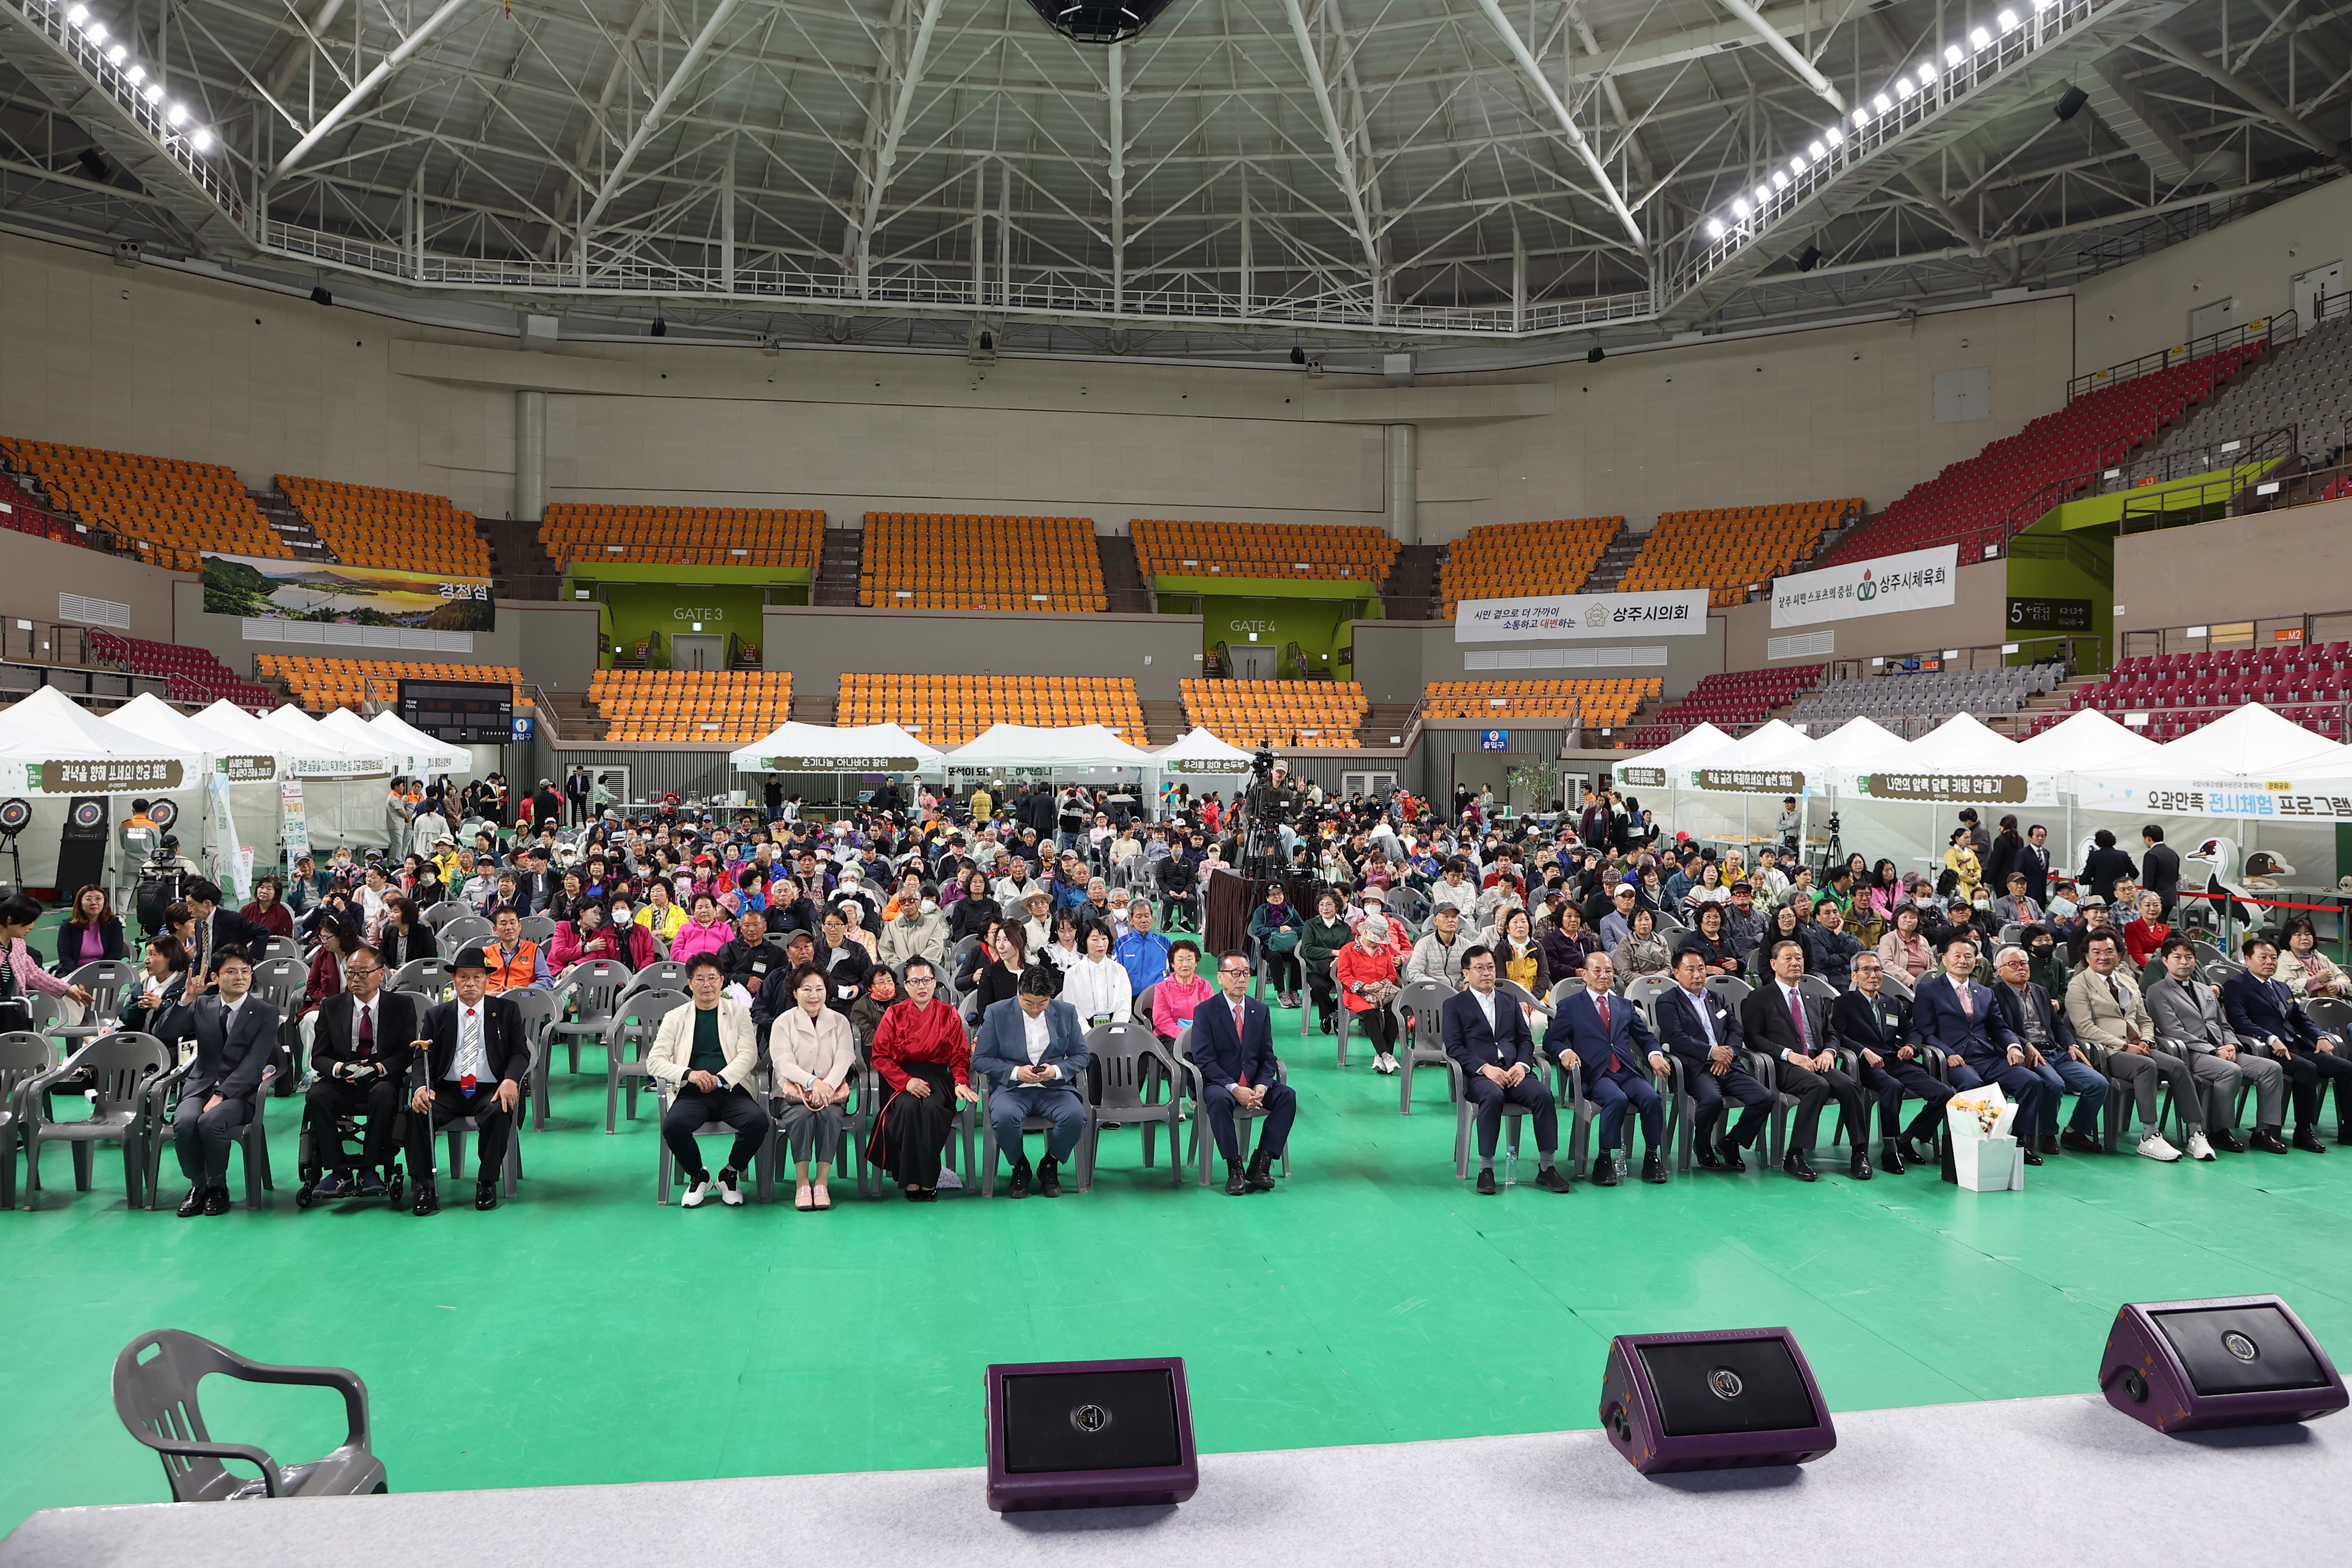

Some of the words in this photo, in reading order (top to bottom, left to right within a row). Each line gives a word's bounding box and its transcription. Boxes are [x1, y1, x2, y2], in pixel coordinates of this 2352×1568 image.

[2147, 477, 2153, 485] L3
[1880, 567, 1945, 593] 상주시체육회
[438, 582, 488, 601] 경천섬
[1793, 592, 1806, 605] 시민
[1807, 587, 1835, 602] 스포츠의
[673, 607, 712, 620] GATE
[714, 608, 723, 620] 3
[1474, 610, 1491, 620] 시민
[1493, 609, 1519, 619] 곁으로
[1522, 608, 1530, 617] 더
[1532, 606, 1559, 617] 가까이
[1613, 605, 1689, 622] 상주시의회
[2011, 603, 2022, 622] 5
[1230, 620, 1265, 631] GATE
[1268, 621, 1276, 632] 4
[1503, 620, 1537, 630] 소통하고
[1540, 618, 1576, 629] 대변하는
[2288, 630, 2300, 640] M2
[520, 721, 524, 730] 1
[308, 760, 320, 772] 심장을
[322, 761, 330, 771] 다시
[339, 761, 347, 771] 하는
[353, 760, 361, 771] 지금
[802, 758, 834, 767] 온기나눔
[836, 758, 870, 767] 아나바다
[872, 758, 888, 767] 장터
[1207, 761, 1221, 769] 엄마
[1223, 761, 1244, 769] 손두부
[61, 765, 88, 781] 과녁을
[90, 765, 107, 781] 향해
[108, 765, 134, 781] 쏘세요!
[136, 765, 150, 780] 한궁
[152, 764, 167, 779] 체험
[1733, 773, 1764, 785] 득점하세요!
[1765, 775, 1778, 786] 슐런
[1779, 774, 1792, 787] 체험
[1886, 777, 1911, 790] 나만의
[1913, 778, 1929, 792] 알록
[1932, 778, 1949, 793] 달록
[1952, 779, 1970, 793] 키링
[1973, 779, 2002, 793] 만들기
[2147, 791, 2204, 812] 오감만족
[2209, 793, 2273, 815] 전시체험
[2279, 796, 2352, 817] 프로그램
